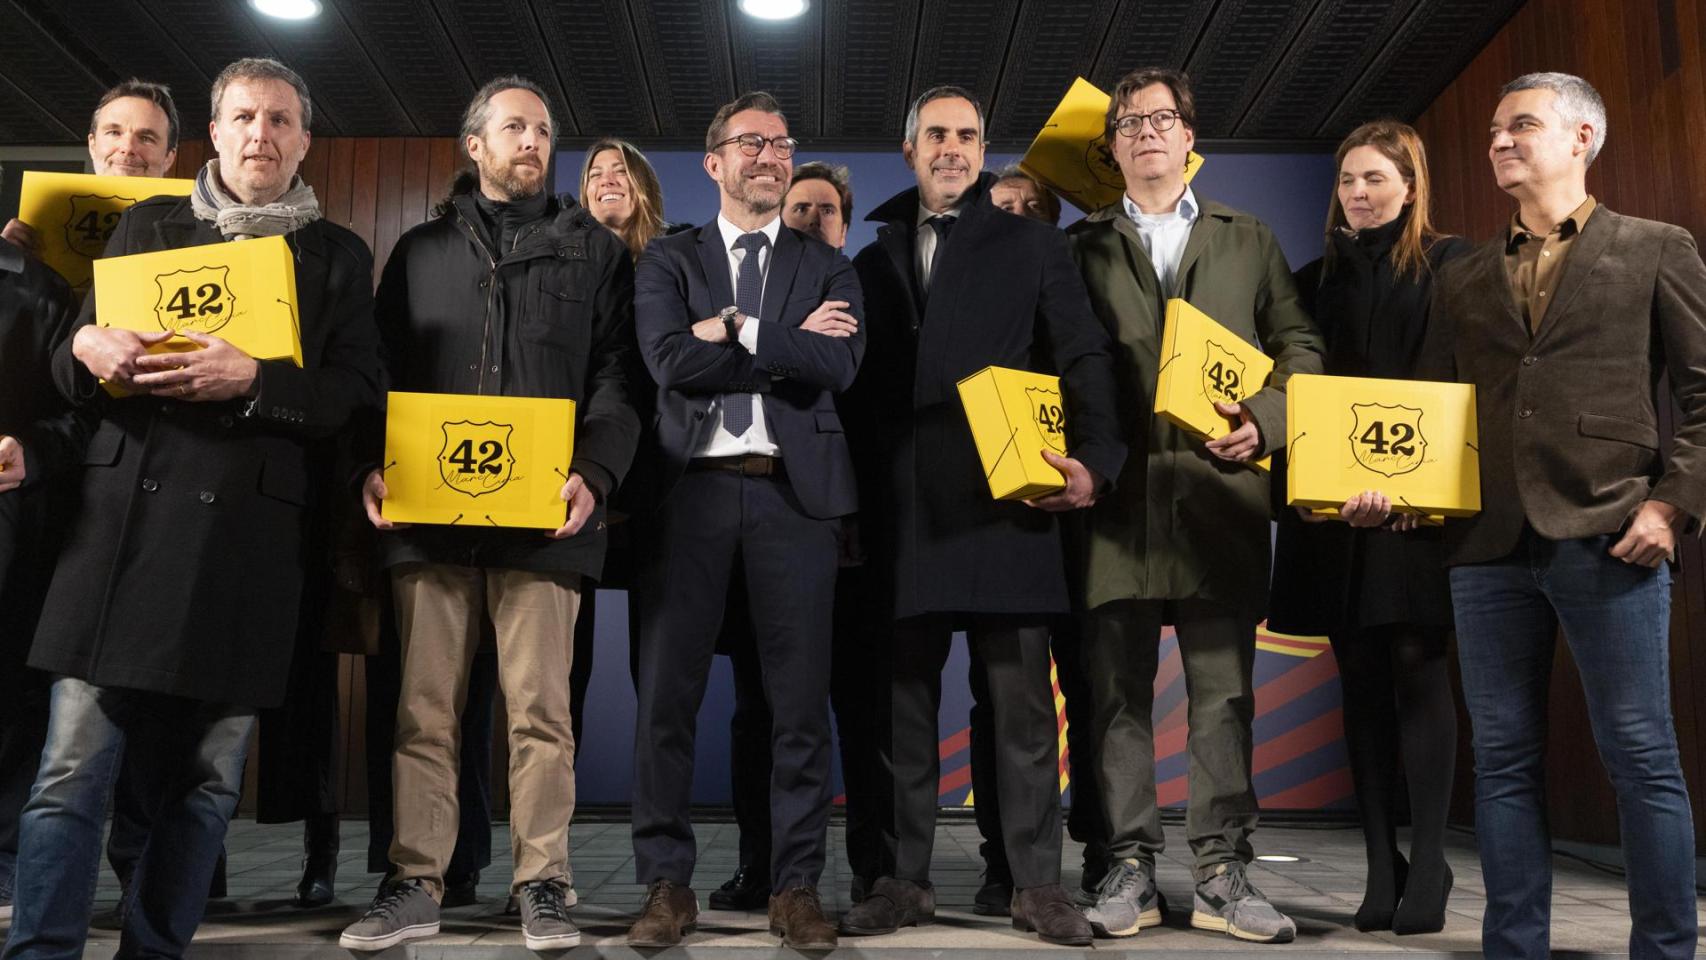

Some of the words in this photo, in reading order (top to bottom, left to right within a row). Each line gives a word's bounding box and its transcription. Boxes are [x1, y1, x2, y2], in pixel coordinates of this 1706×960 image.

[166, 283, 223, 319] 42
[1208, 361, 1239, 401] 42
[1039, 403, 1065, 434] 42
[1360, 421, 1415, 456] 42
[448, 439, 503, 475] 42
